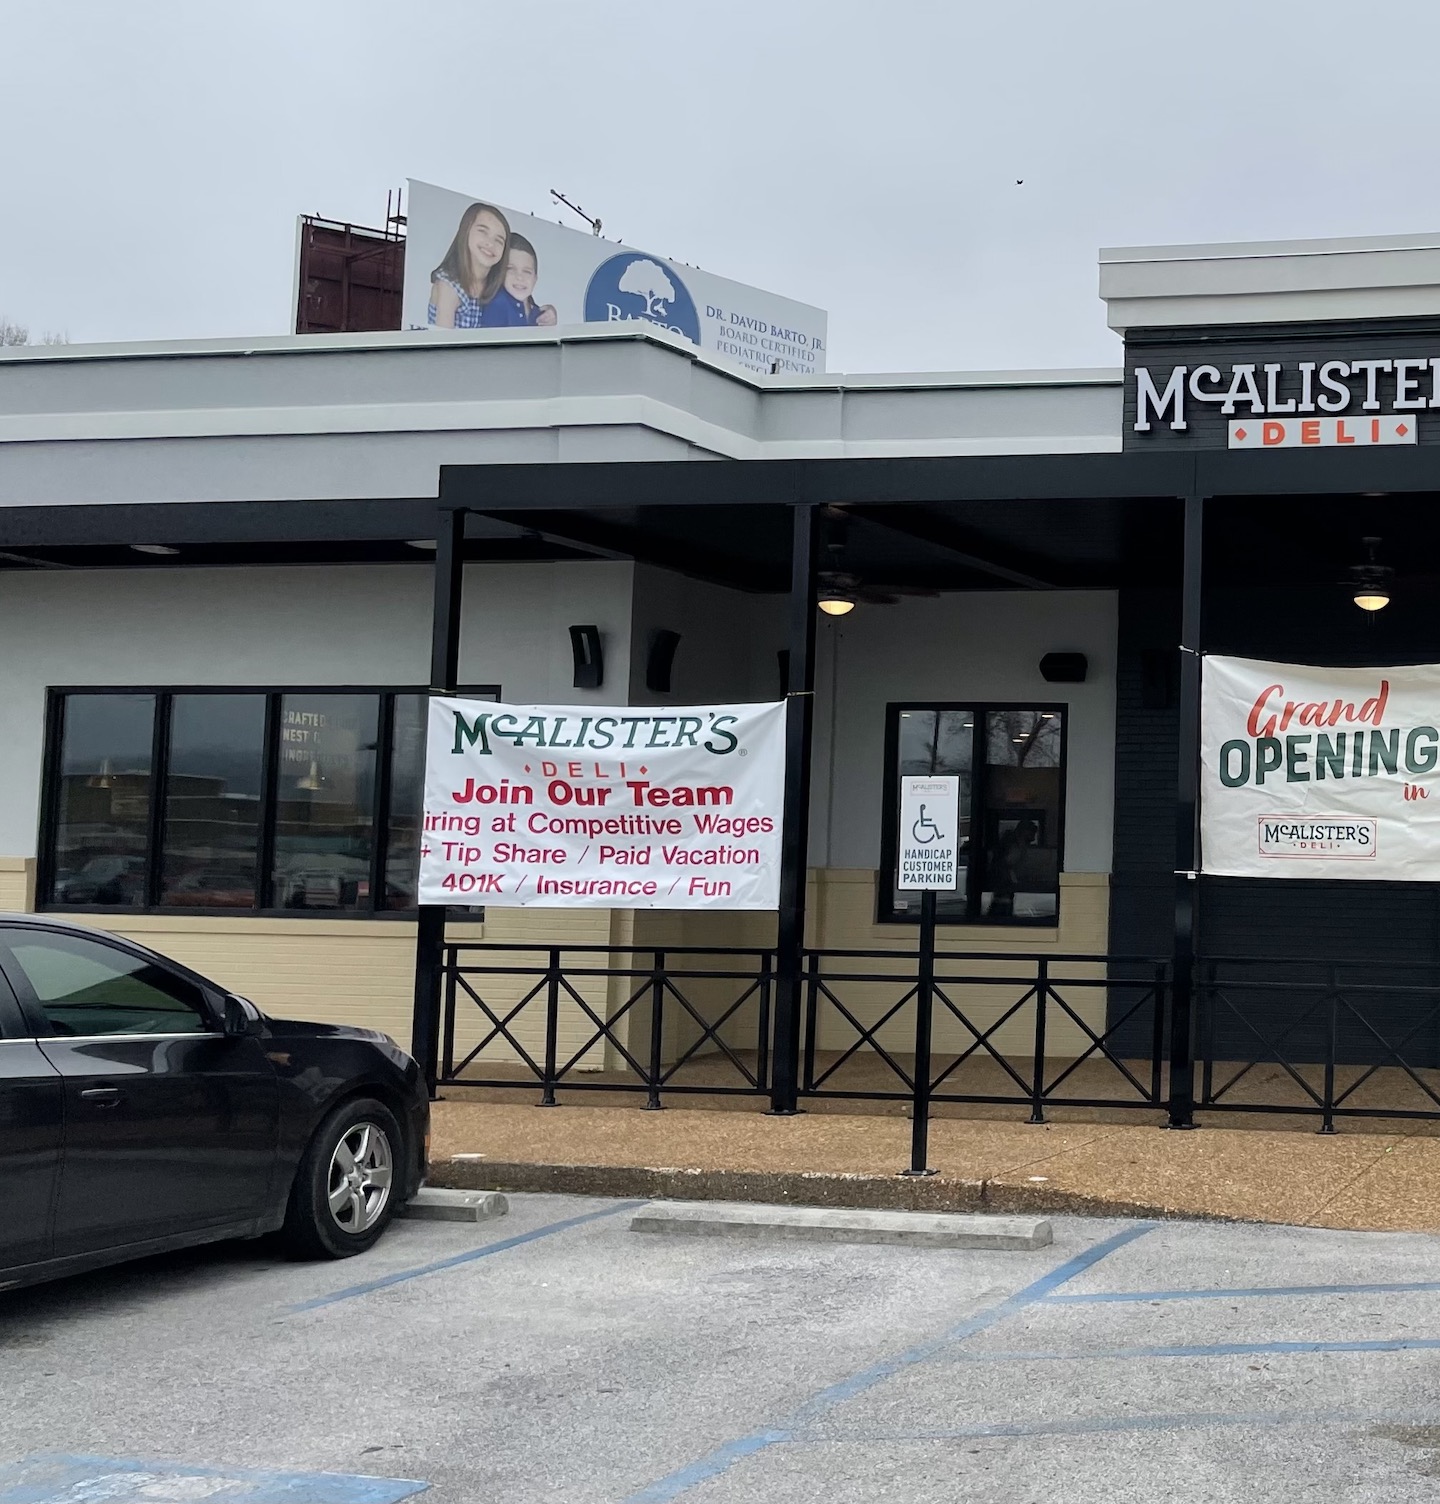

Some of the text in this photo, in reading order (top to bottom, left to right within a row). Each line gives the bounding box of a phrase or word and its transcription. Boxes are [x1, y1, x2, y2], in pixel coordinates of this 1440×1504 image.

[706, 305, 727, 321] DR.
[730, 313, 767, 333] DAVID
[770, 325, 809, 347] BARTO,
[811, 337, 826, 351] JR.
[717, 340, 772, 365] PEDIATRIC
[720, 325, 815, 362] BOARD CERTIFIED
[1262, 419, 1380, 446] DELI
[1247, 680, 1389, 739] Grand
[1219, 726, 1439, 788] OPENING
[541, 762, 628, 778] DELI
[452, 778, 734, 807] Join Our Team
[1403, 782, 1430, 802] in
[424, 810, 774, 838] iring at Competitive Wages
[441, 842, 482, 866] Tip
[493, 842, 567, 865] Share
[577, 845, 590, 865] /
[599, 844, 651, 865] Paid
[662, 845, 760, 865] Vacation
[903, 861, 953, 871] CUSTOMER
[904, 849, 952, 859] HANDICAP
[441, 872, 731, 896] 401K / Insurance / Fun
[903, 873, 952, 883] PARKING
